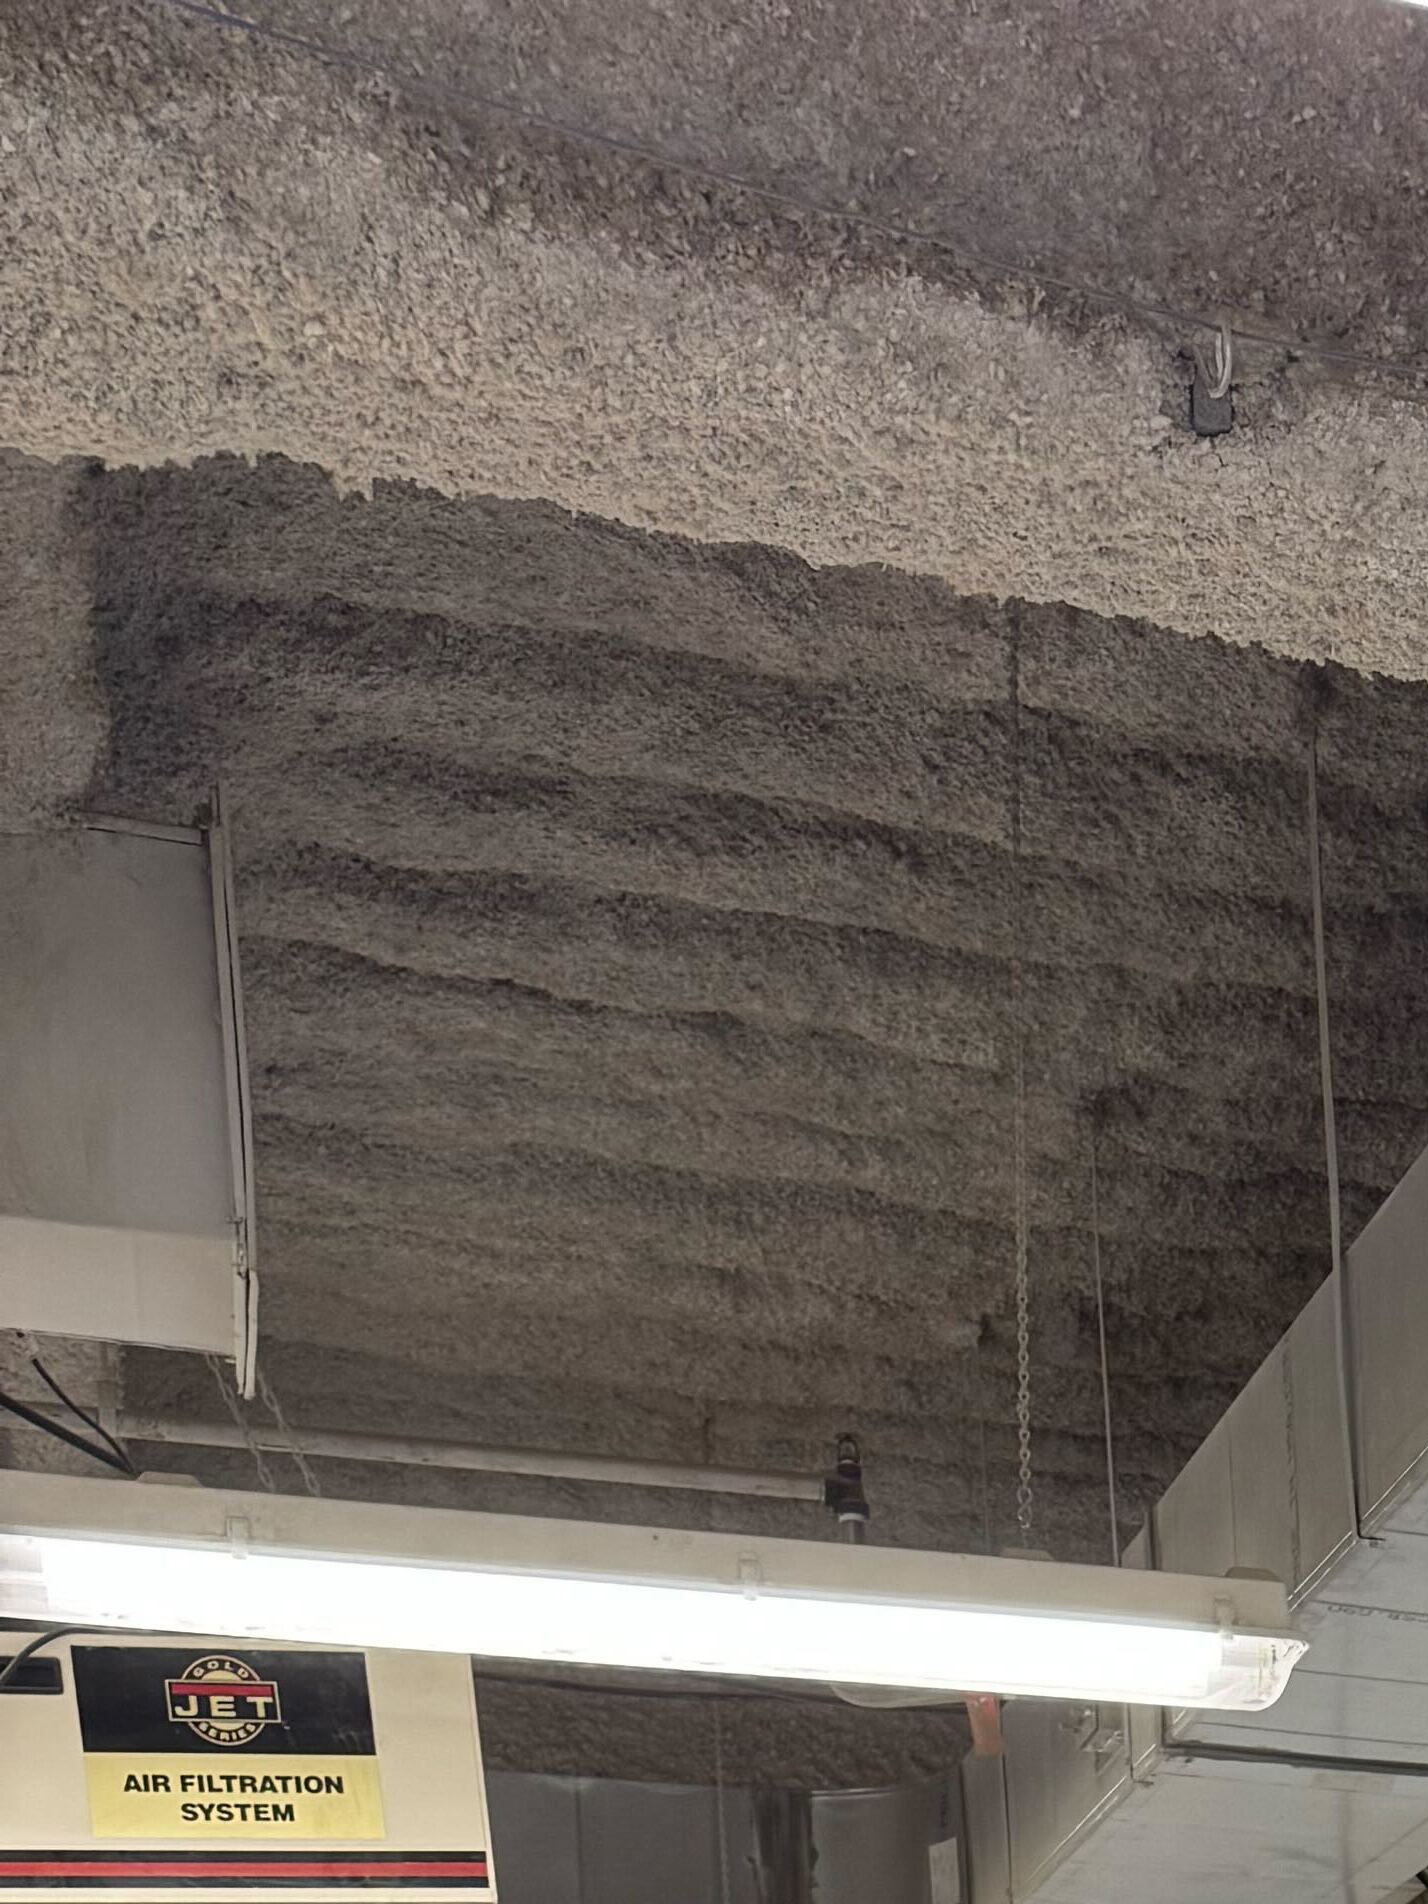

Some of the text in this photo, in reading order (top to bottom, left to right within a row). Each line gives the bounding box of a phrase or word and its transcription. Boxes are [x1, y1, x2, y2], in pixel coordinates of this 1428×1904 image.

[193, 1659, 250, 1679] GOLD
[175, 1695, 275, 1718] JET
[198, 1722, 257, 1741] SERIES
[123, 1774, 345, 1794] AIR FILTRATION
[181, 1803, 295, 1822] SYSTEM
